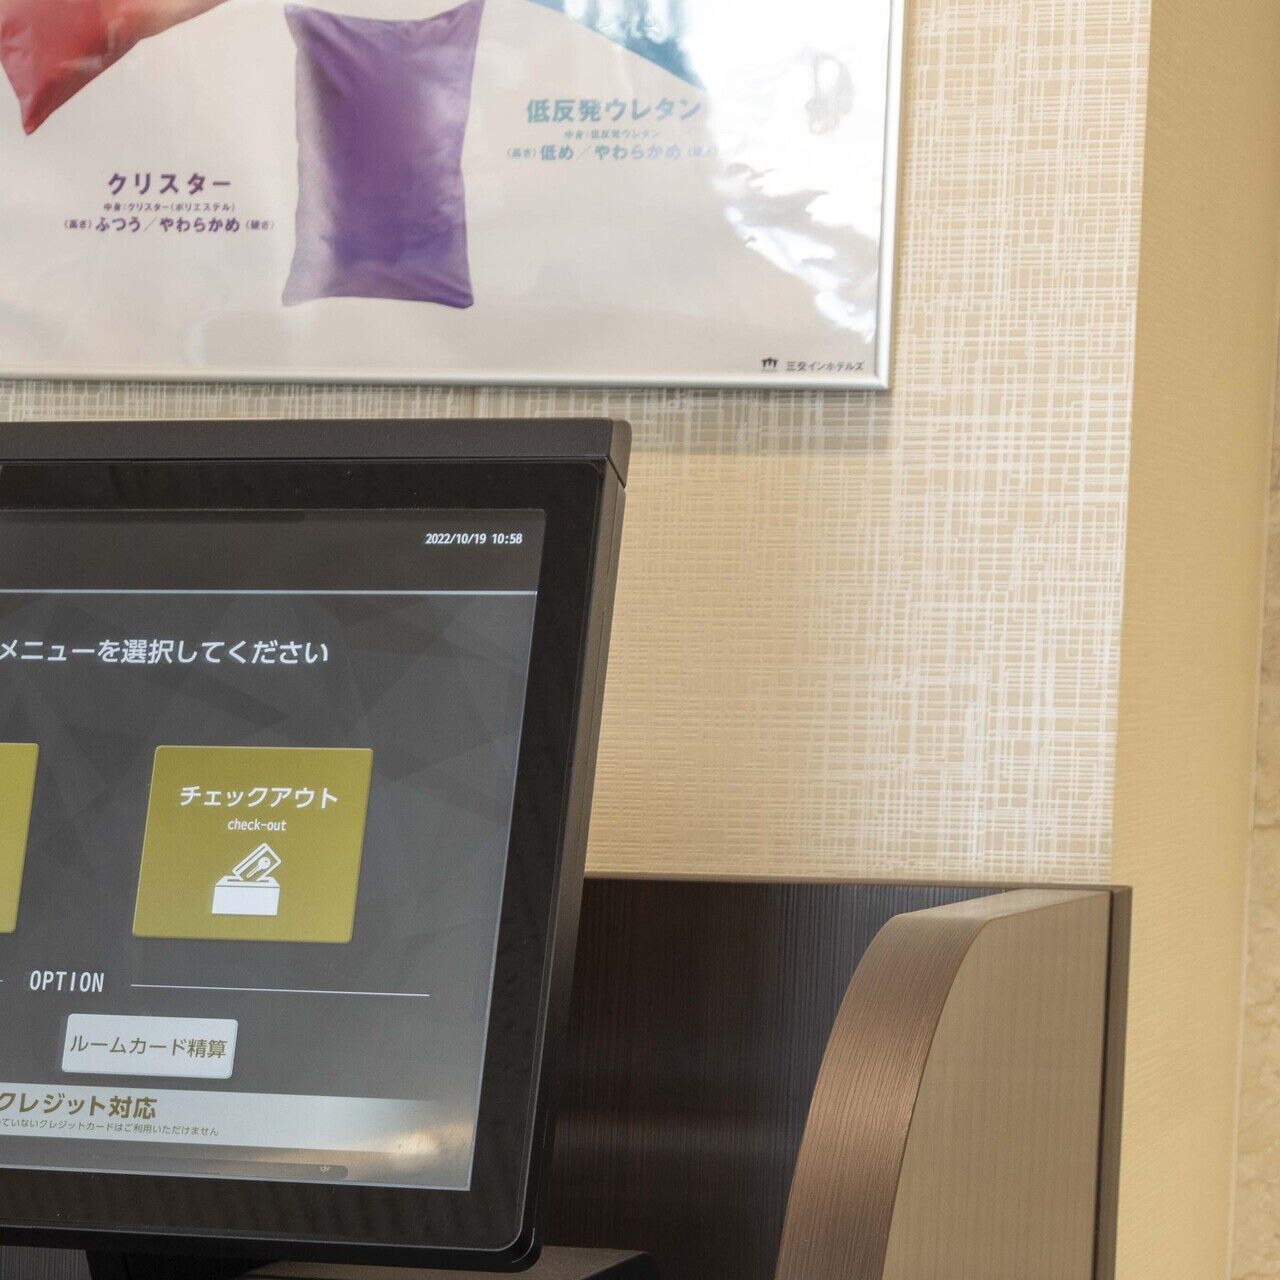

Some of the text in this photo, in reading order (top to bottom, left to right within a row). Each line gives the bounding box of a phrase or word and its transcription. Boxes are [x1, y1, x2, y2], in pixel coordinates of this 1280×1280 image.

[526, 98, 702, 123] 低反発ウレタン
[108, 172, 231, 196] クリスター
[425, 533, 523, 546] 2022/10/19 10:58
[180, 784, 339, 811] チェックアウト
[227, 818, 287, 832] check-out
[29, 970, 105, 994] OPTION
[69, 1034, 227, 1061] ルームカード精算
